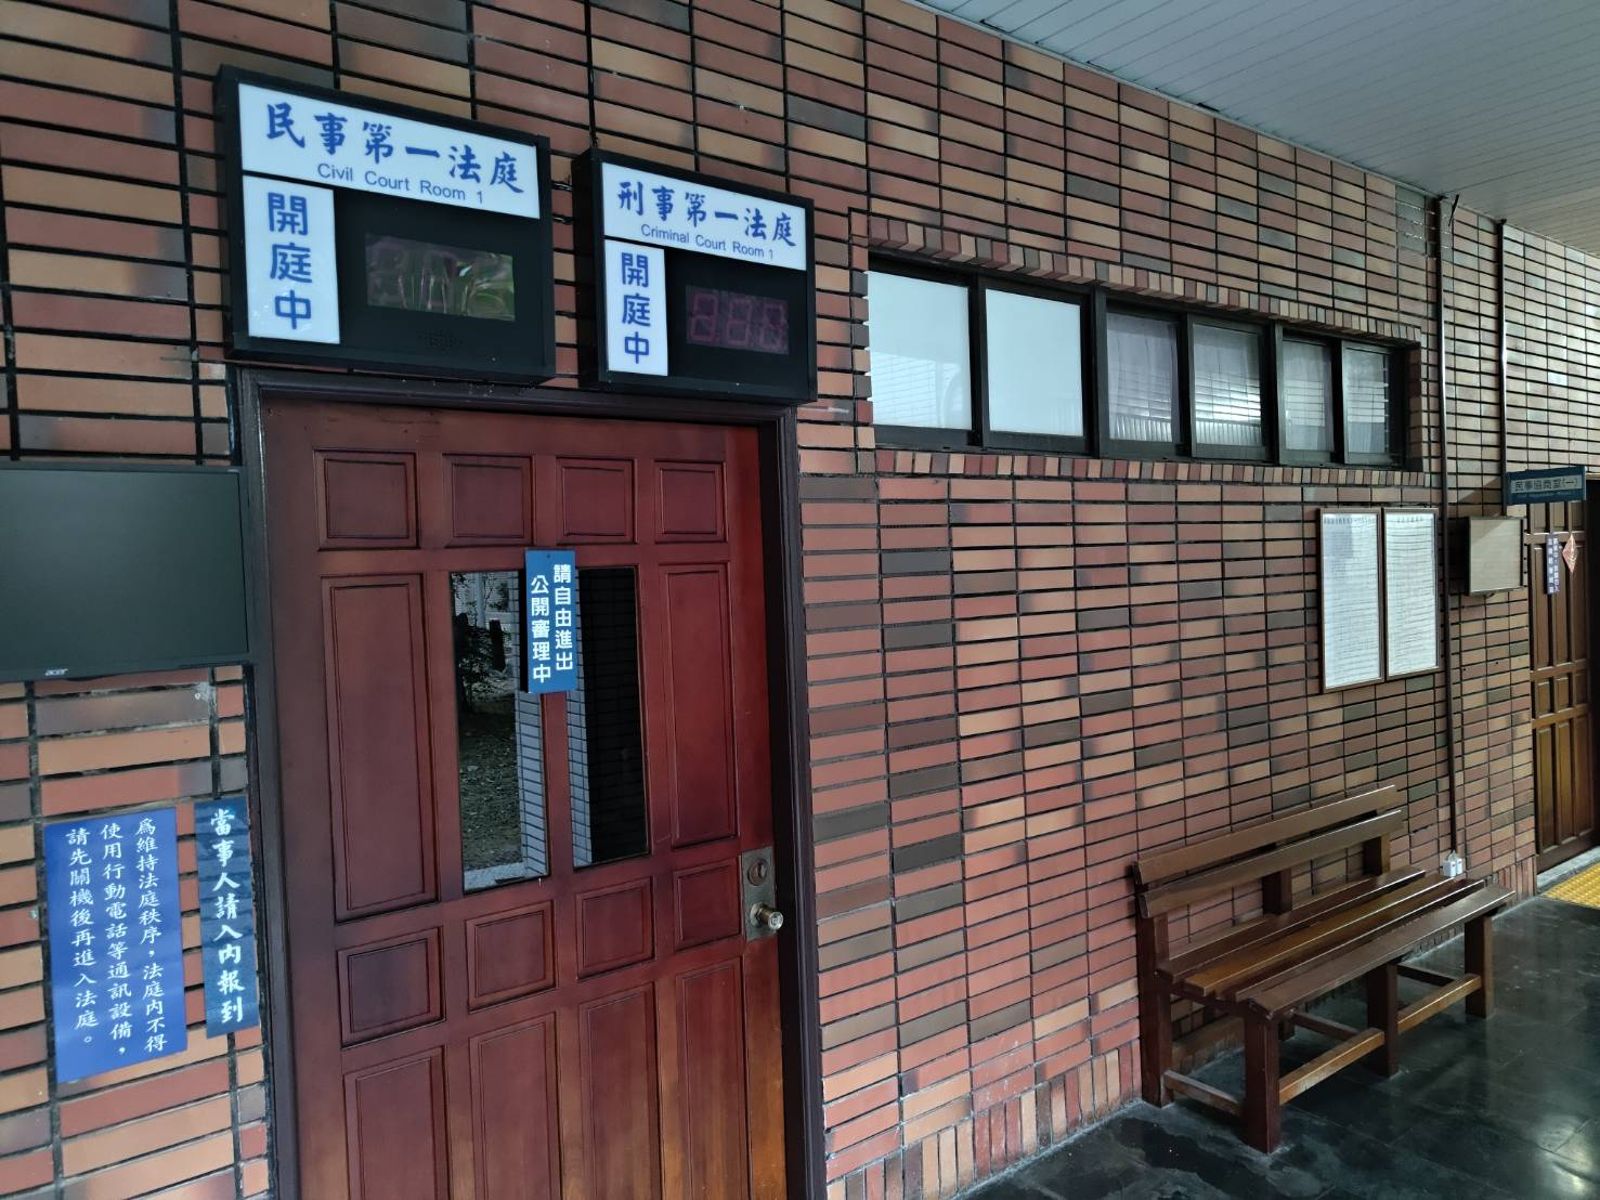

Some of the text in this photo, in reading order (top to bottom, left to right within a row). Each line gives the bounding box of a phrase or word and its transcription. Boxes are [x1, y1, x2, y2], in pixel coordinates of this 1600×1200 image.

[267, 102, 524, 194] 民事第一法庭
[317, 163, 483, 204] Civil Court Room 1
[268, 192, 312, 330] 開庭中
[618, 181, 796, 247] 刑事第一法庭
[641, 224, 774, 259] Criminal Court Room 1
[621, 252, 650, 364] 開庭中
[531, 575, 551, 683] 公開審理中
[554, 564, 573, 671] 請自由進出
[66, 828, 99, 1043] 請先關機後再進入法庭。
[100, 823, 133, 1055] 使用行動電話等通訊設備，
[210, 808, 245, 1024] 當事人請入內報到
